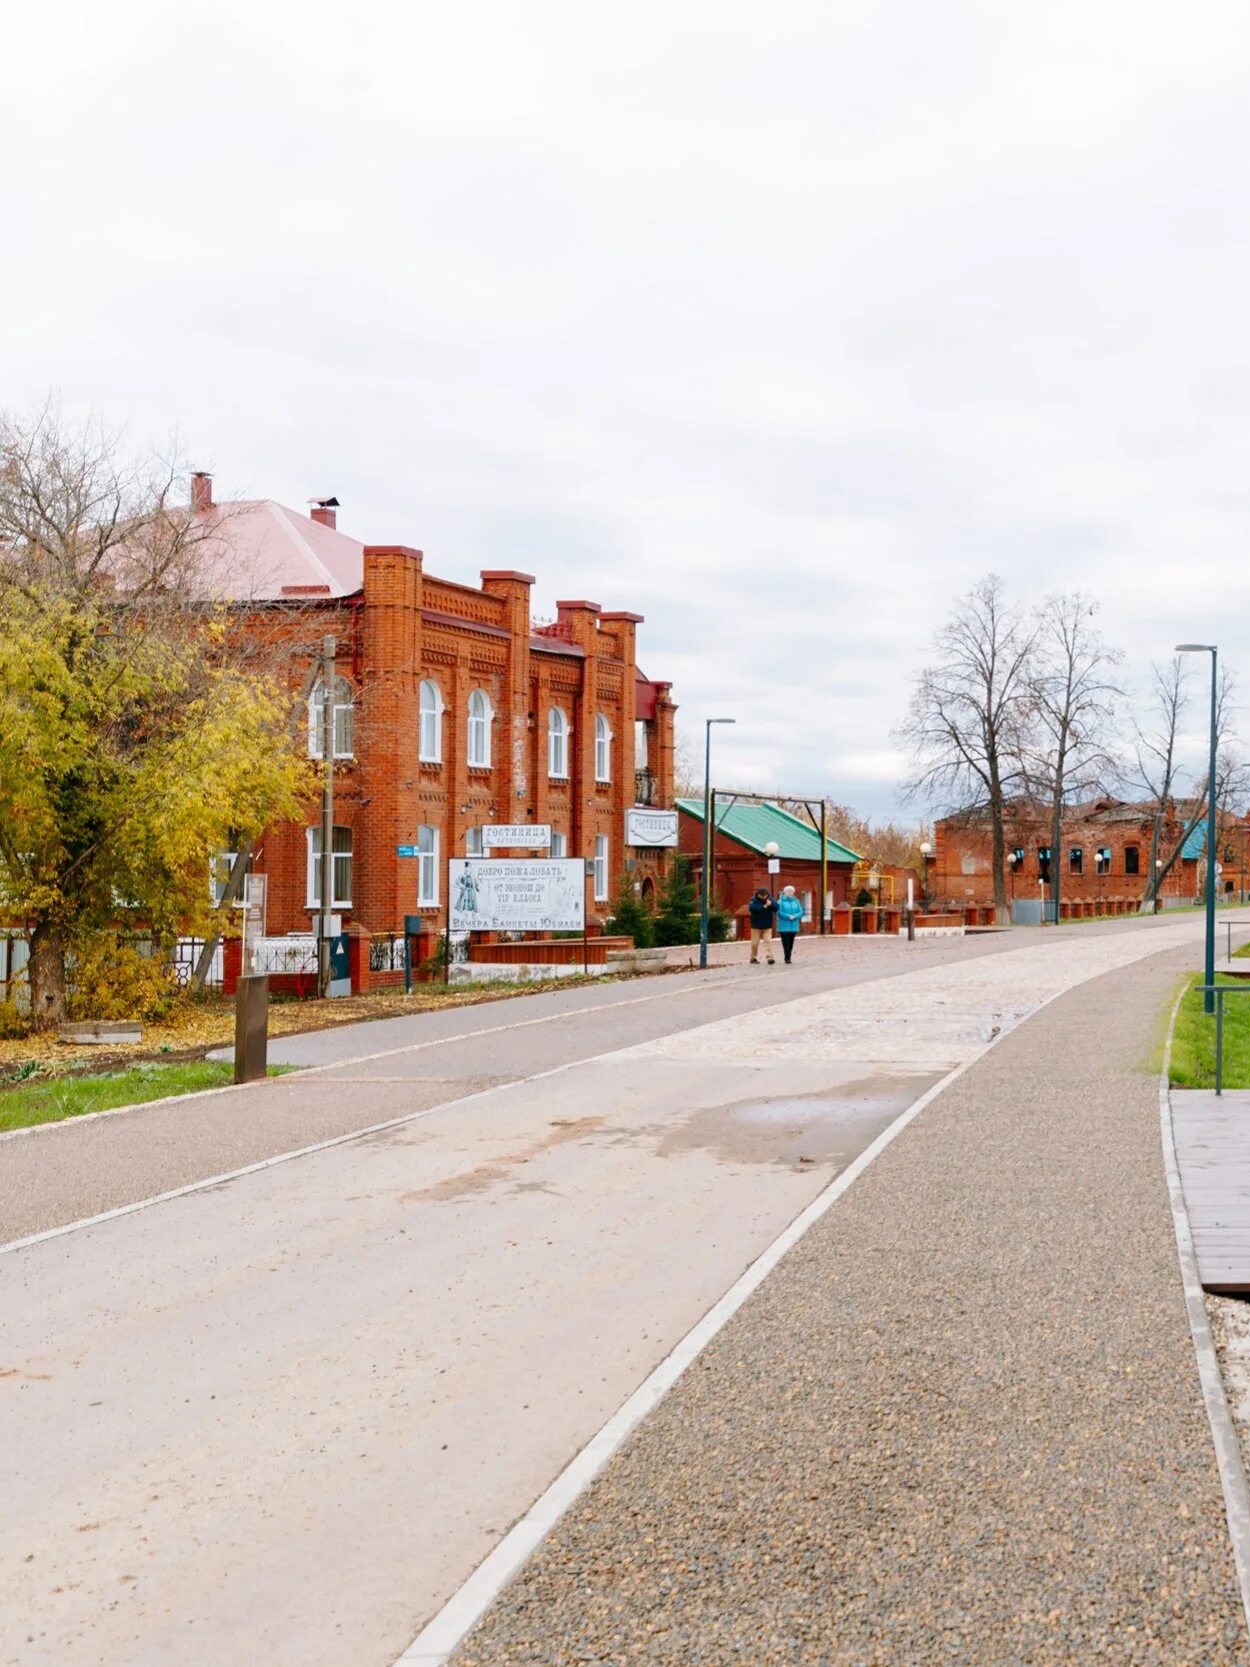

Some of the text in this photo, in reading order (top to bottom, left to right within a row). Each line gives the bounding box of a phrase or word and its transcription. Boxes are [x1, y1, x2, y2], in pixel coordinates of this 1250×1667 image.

[487, 827, 546, 837] ГОСТИНИЦА
[477, 867, 562, 876] ДОБРО ПОЖАЛОВАТЬ
